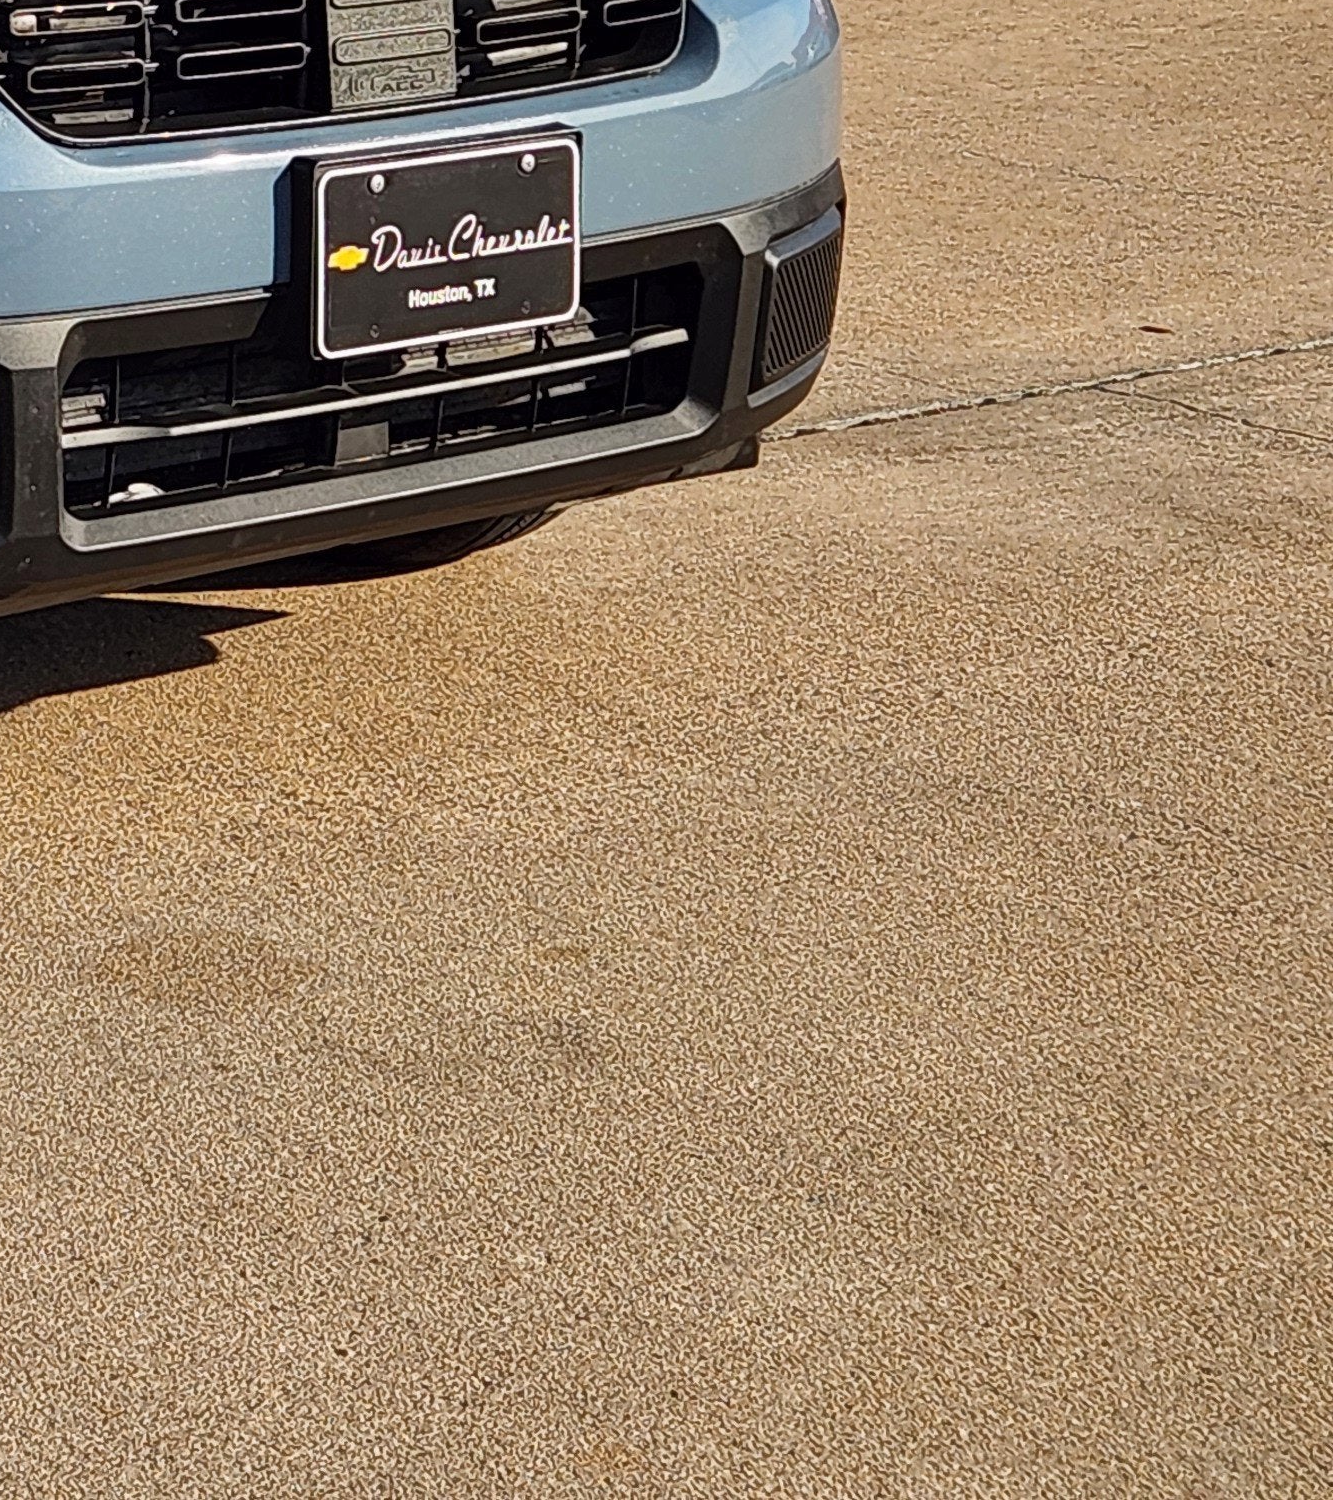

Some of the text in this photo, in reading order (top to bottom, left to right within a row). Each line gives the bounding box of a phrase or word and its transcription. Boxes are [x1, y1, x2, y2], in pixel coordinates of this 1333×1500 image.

[371, 213, 573, 273] Davis Chevrolet
[408, 277, 497, 309] Houston, TX
